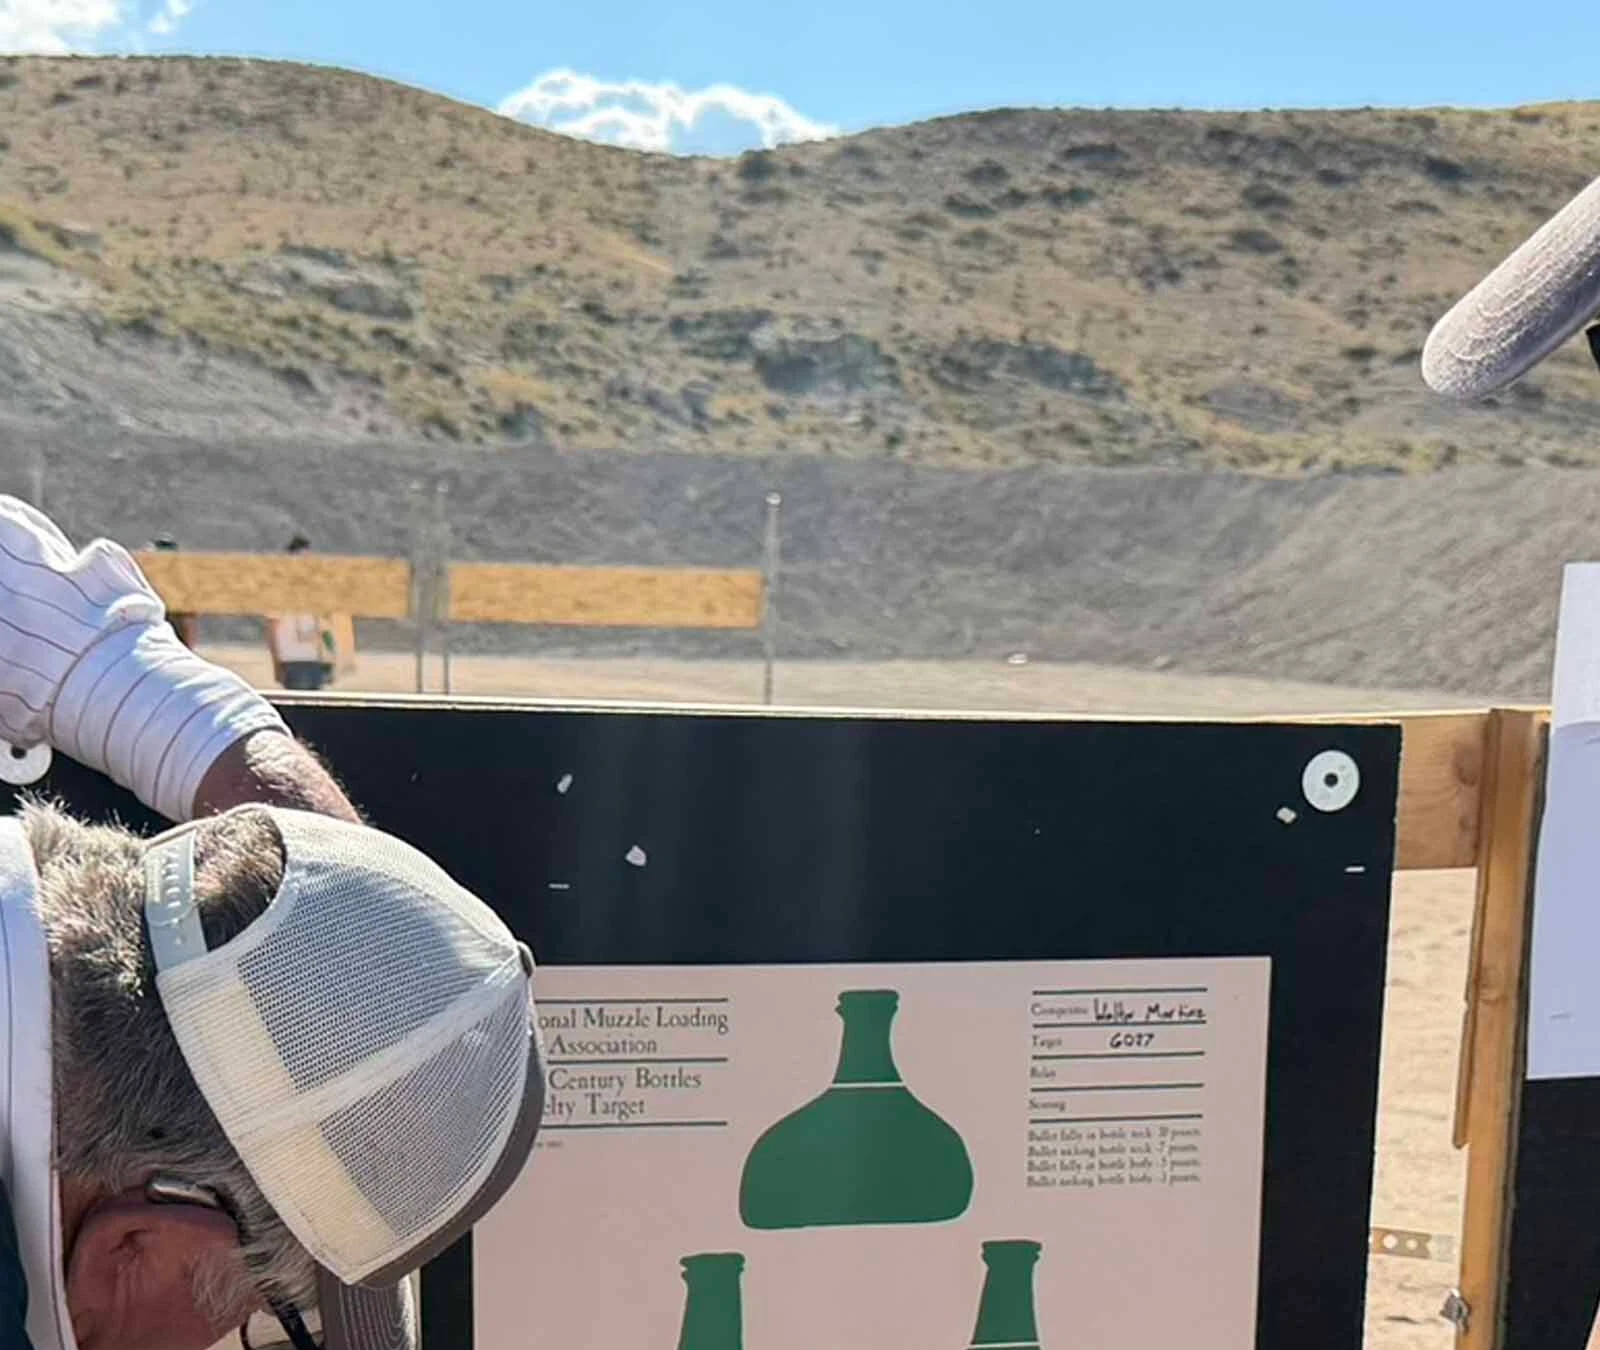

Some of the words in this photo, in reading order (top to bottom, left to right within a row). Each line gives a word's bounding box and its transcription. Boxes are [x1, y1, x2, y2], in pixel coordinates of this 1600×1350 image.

[538, 1007, 577, 1029] onal
[584, 1007, 650, 1029] Muzzle
[656, 1005, 729, 1034] Loading
[550, 1034, 657, 1055] Association
[548, 1067, 625, 1097] Century
[635, 1067, 702, 1090] Bottles
[544, 1094, 576, 1120] elty
[585, 1093, 645, 1121] Target
